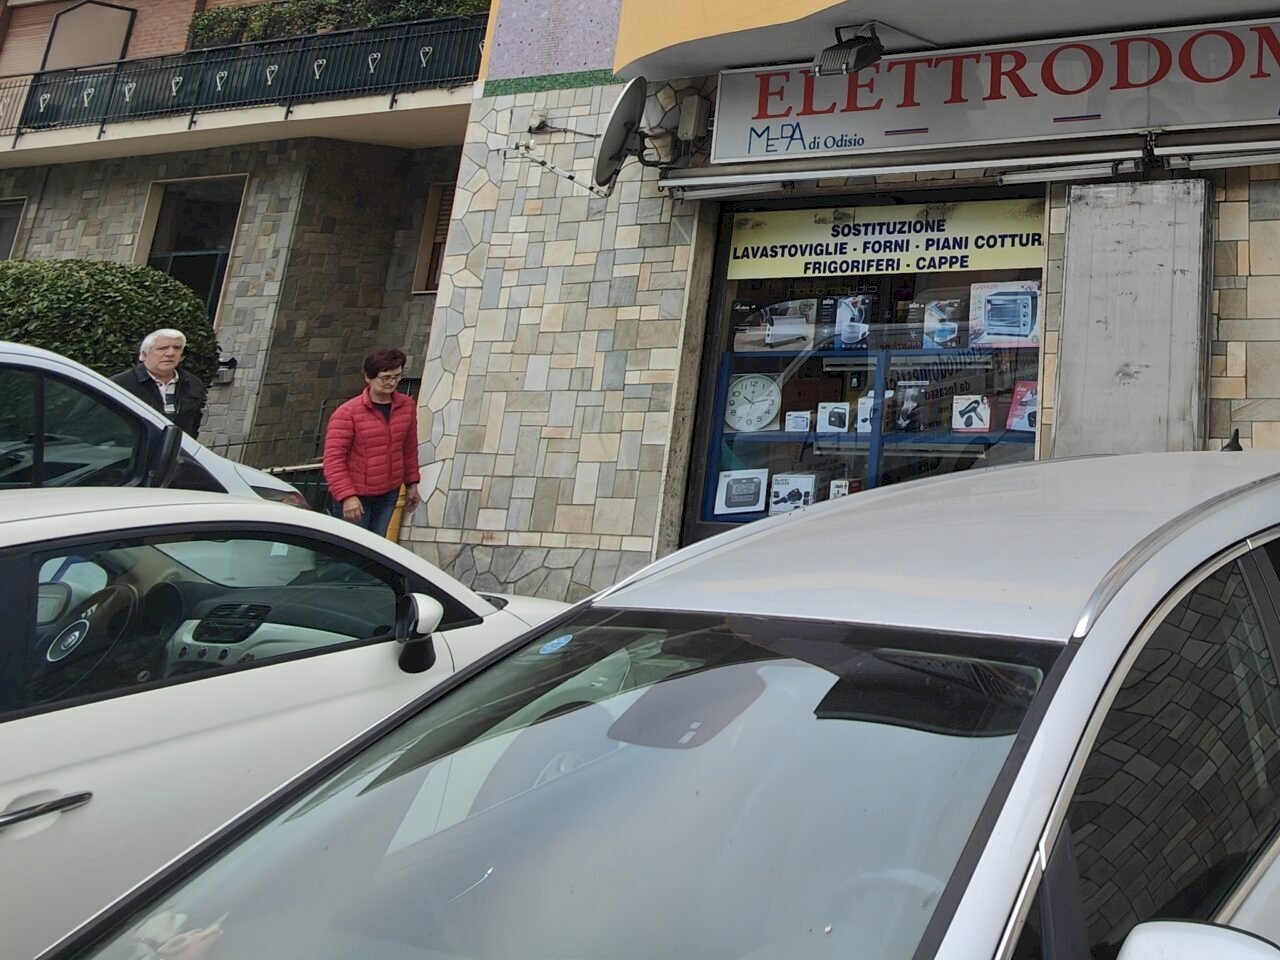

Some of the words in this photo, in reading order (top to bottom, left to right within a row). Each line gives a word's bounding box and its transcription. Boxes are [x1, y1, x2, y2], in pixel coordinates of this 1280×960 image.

[808, 136, 820, 150] di
[823, 133, 865, 149] Odisio
[831, 218, 946, 238] SOSTITUZIONE
[732, 242, 849, 260] LAVASTOVIGLIE
[862, 240, 910, 254] FORNI
[925, 236, 969, 252] PIANI
[974, 232, 1044, 249] COTTUR
[803, 257, 901, 275] FRIGORIFERI
[915, 255, 970, 271] CAPPE
